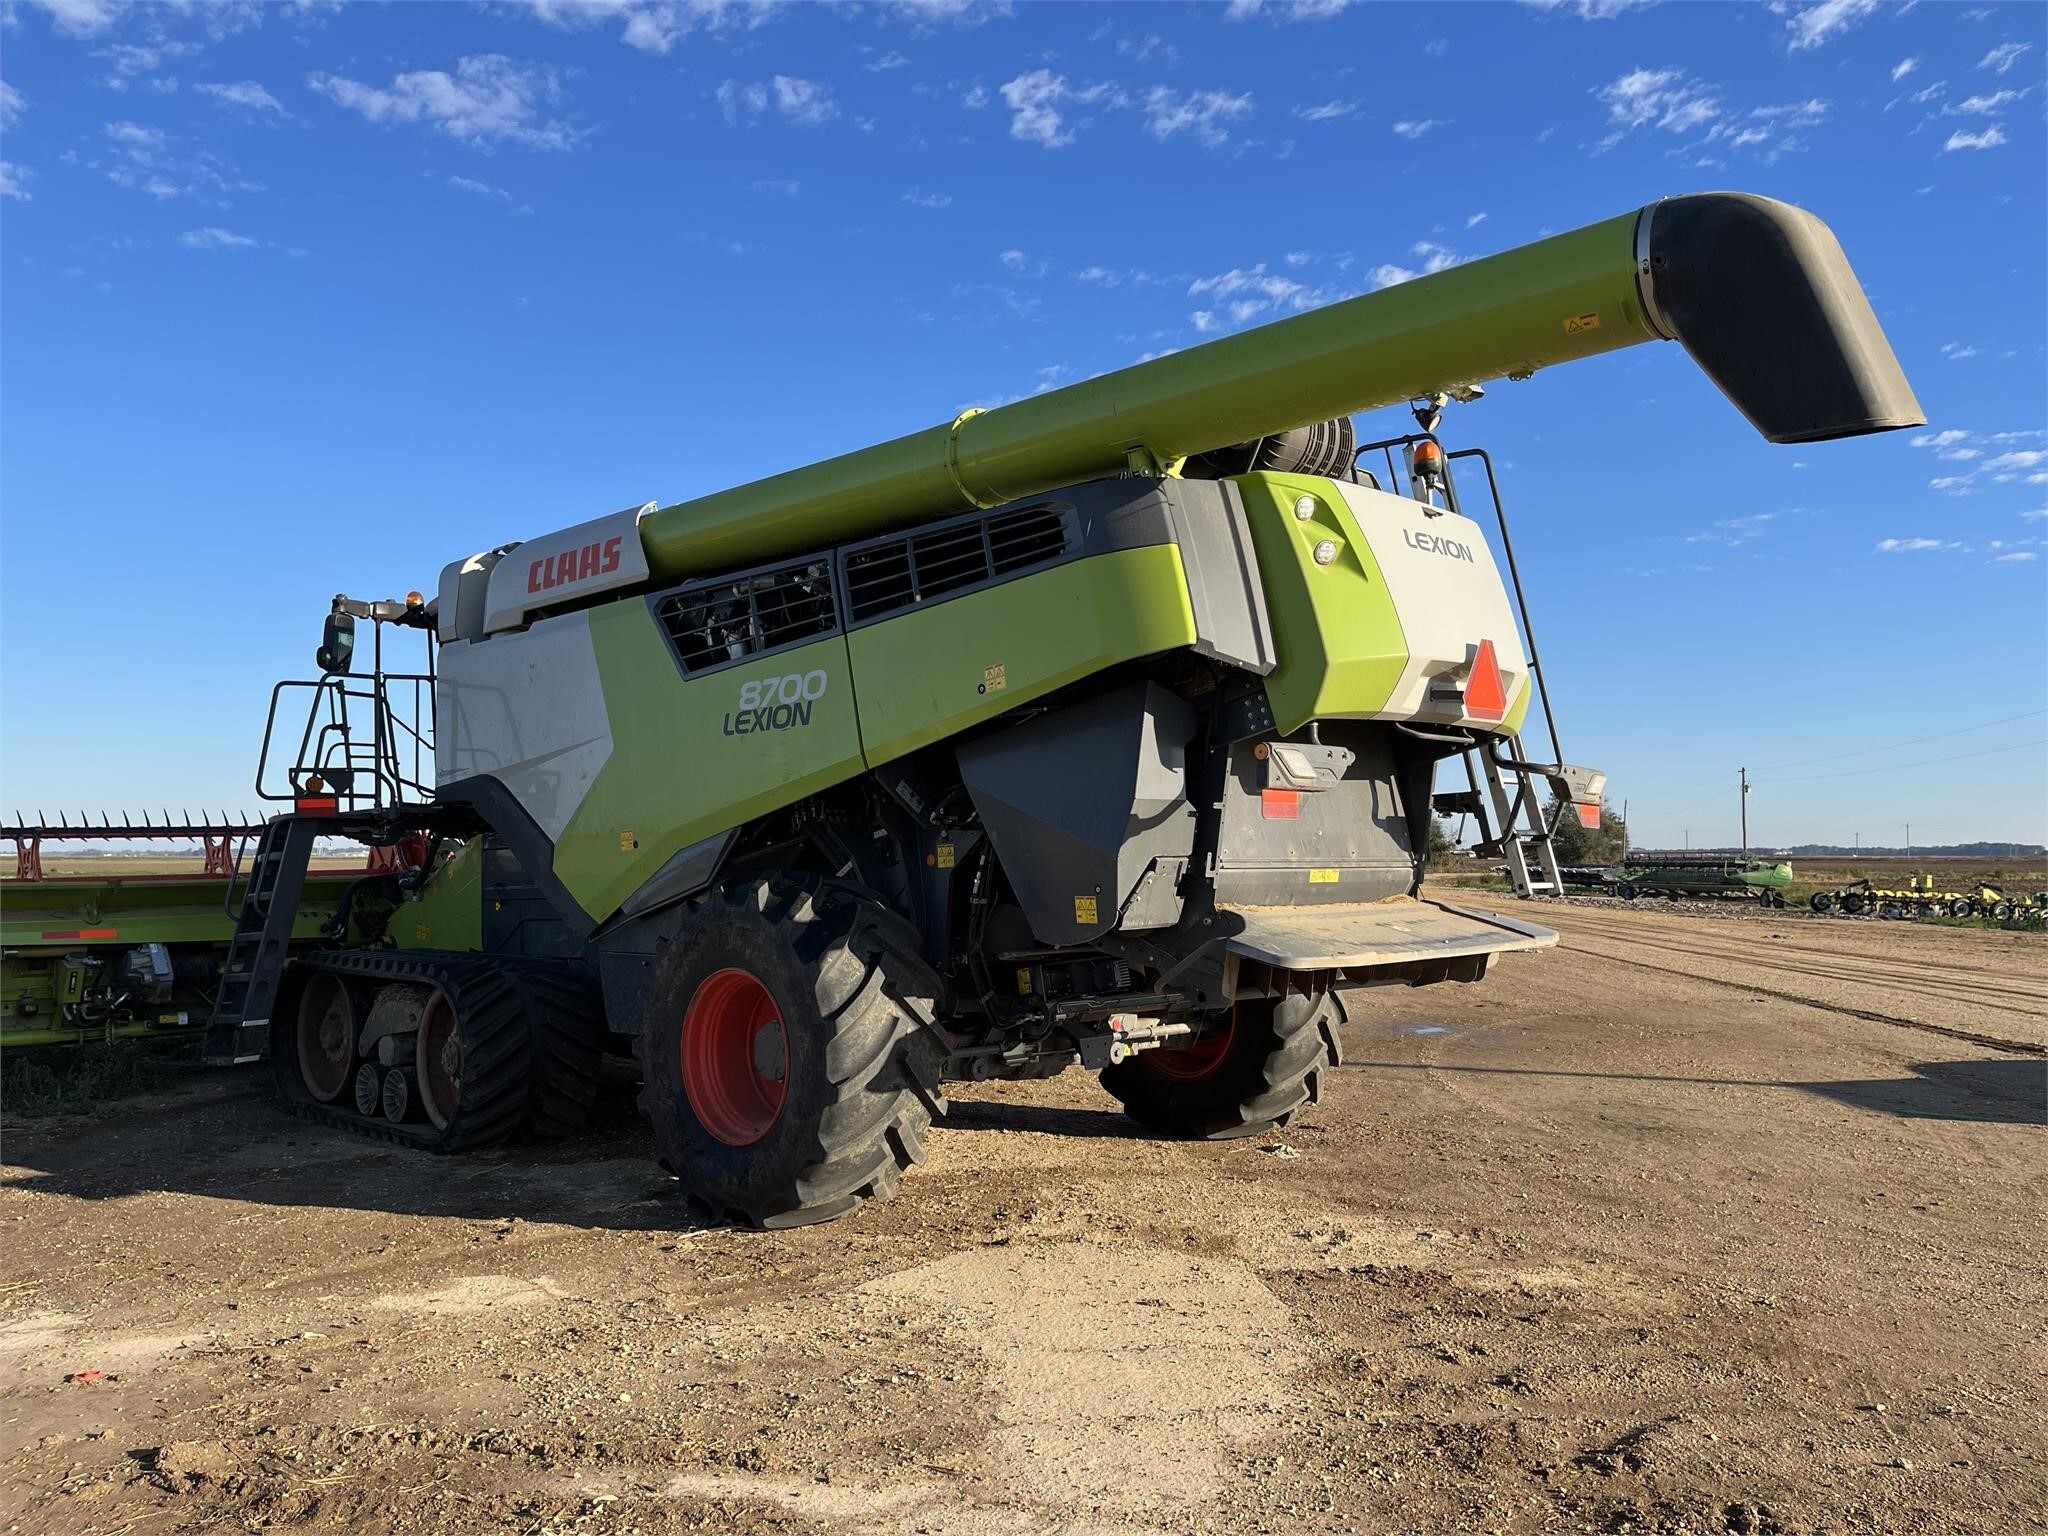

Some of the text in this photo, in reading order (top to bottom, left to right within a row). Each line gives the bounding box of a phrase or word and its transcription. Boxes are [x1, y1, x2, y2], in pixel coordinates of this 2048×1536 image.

[528, 536, 622, 593] CLAAS
[1403, 528, 1474, 563] LEXION
[739, 669, 827, 711] 8700
[723, 700, 812, 736] LEXION
